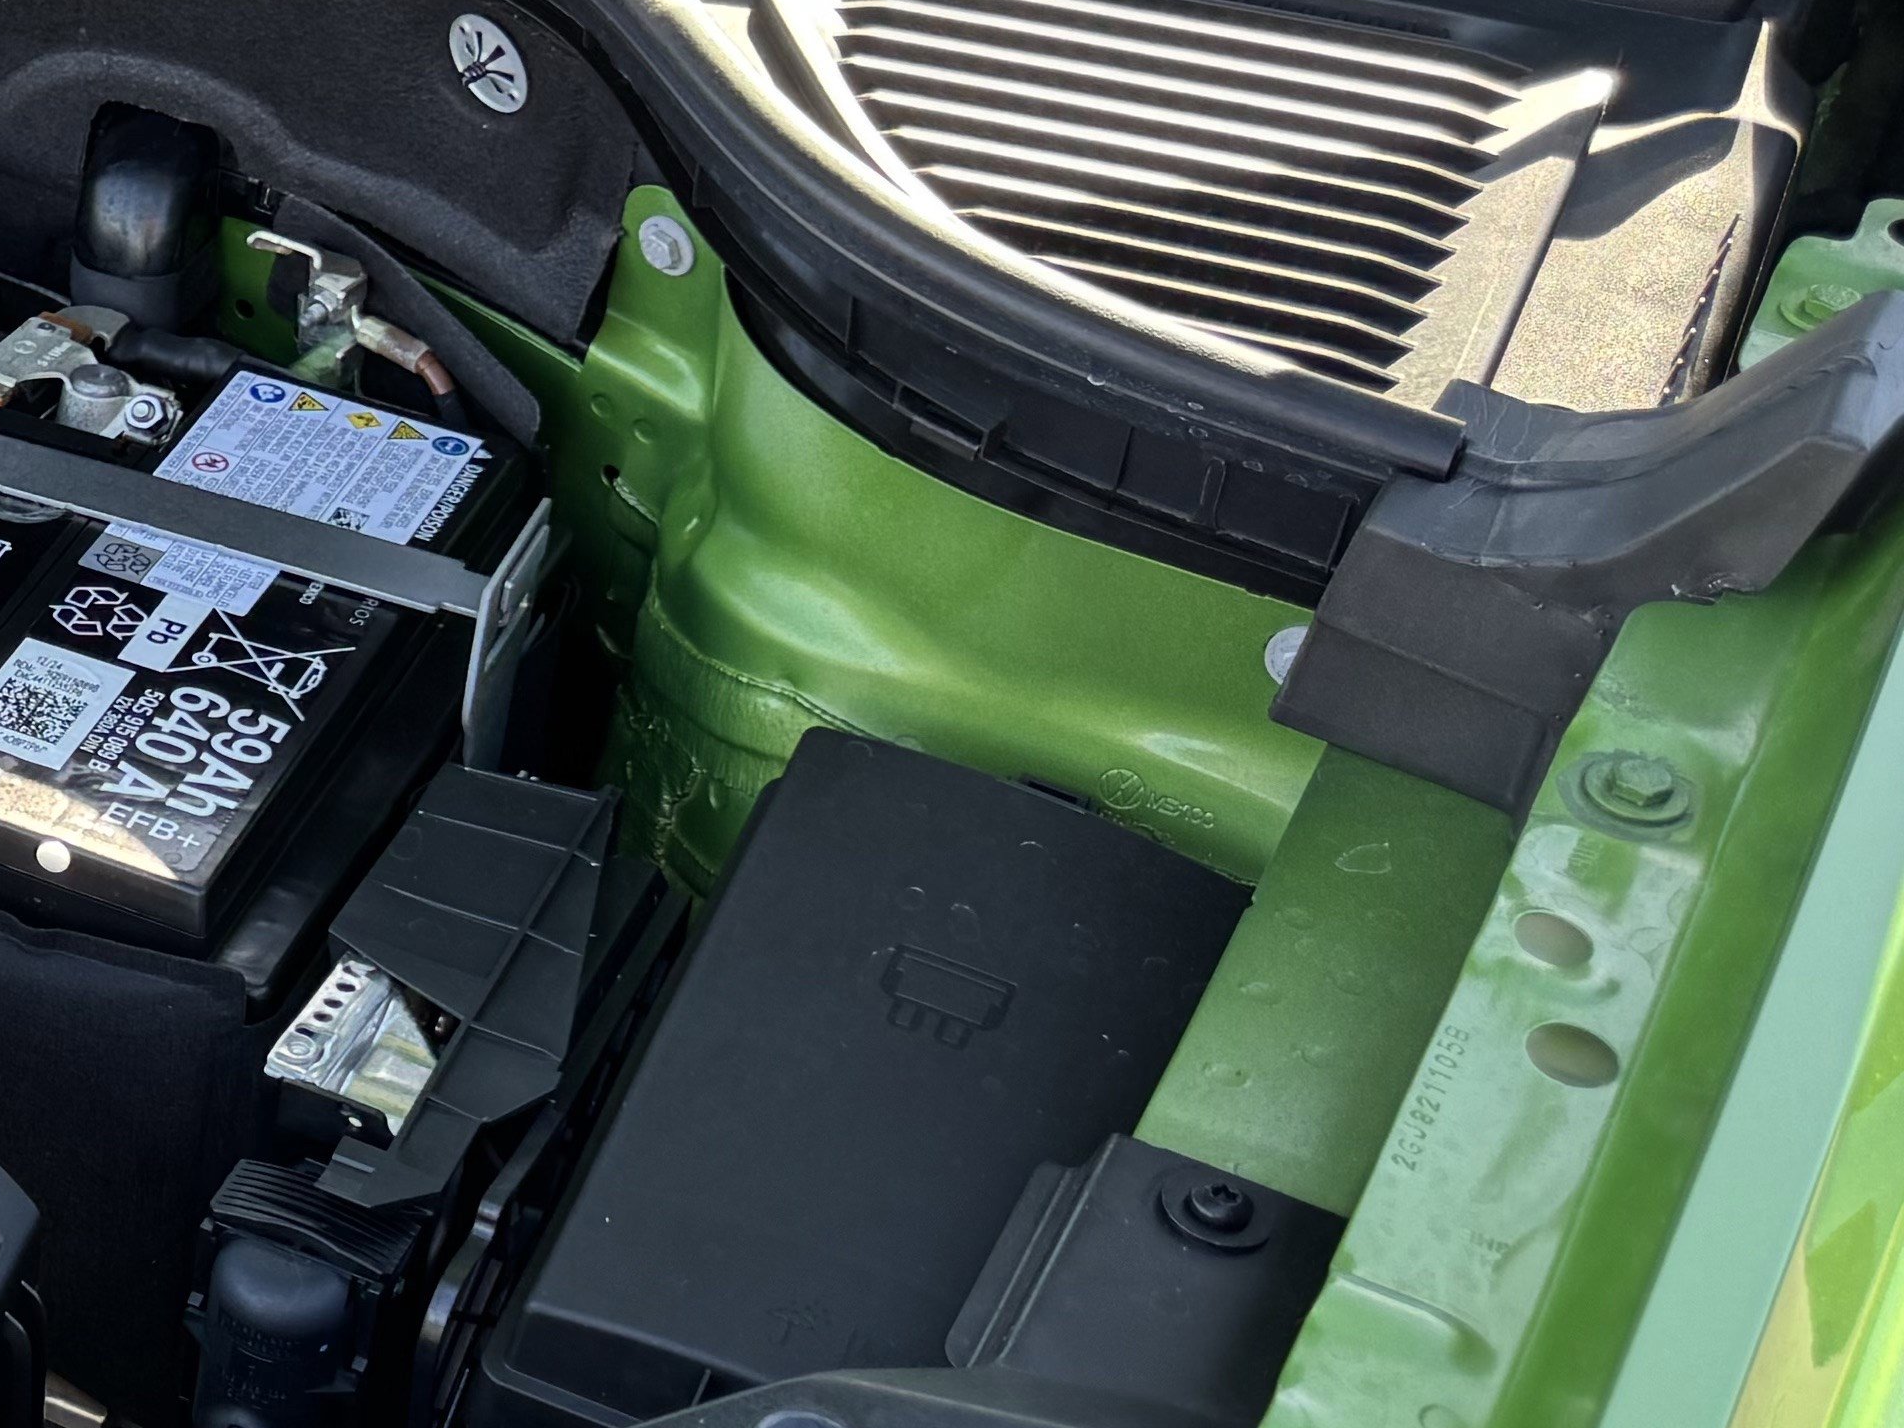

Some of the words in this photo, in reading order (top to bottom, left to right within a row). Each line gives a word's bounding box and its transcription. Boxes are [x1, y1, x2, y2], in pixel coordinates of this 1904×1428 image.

[145, 617, 187, 645] Pb
[112, 694, 135, 713] 12V
[92, 709, 122, 734] 380A
[114, 714, 144, 738] 915
[135, 686, 230, 763] 640
[78, 732, 104, 753] DIN
[96, 735, 128, 760] 089
[86, 757, 111, 773] B
[165, 708, 288, 816] 59Ah
[98, 760, 172, 801] A
